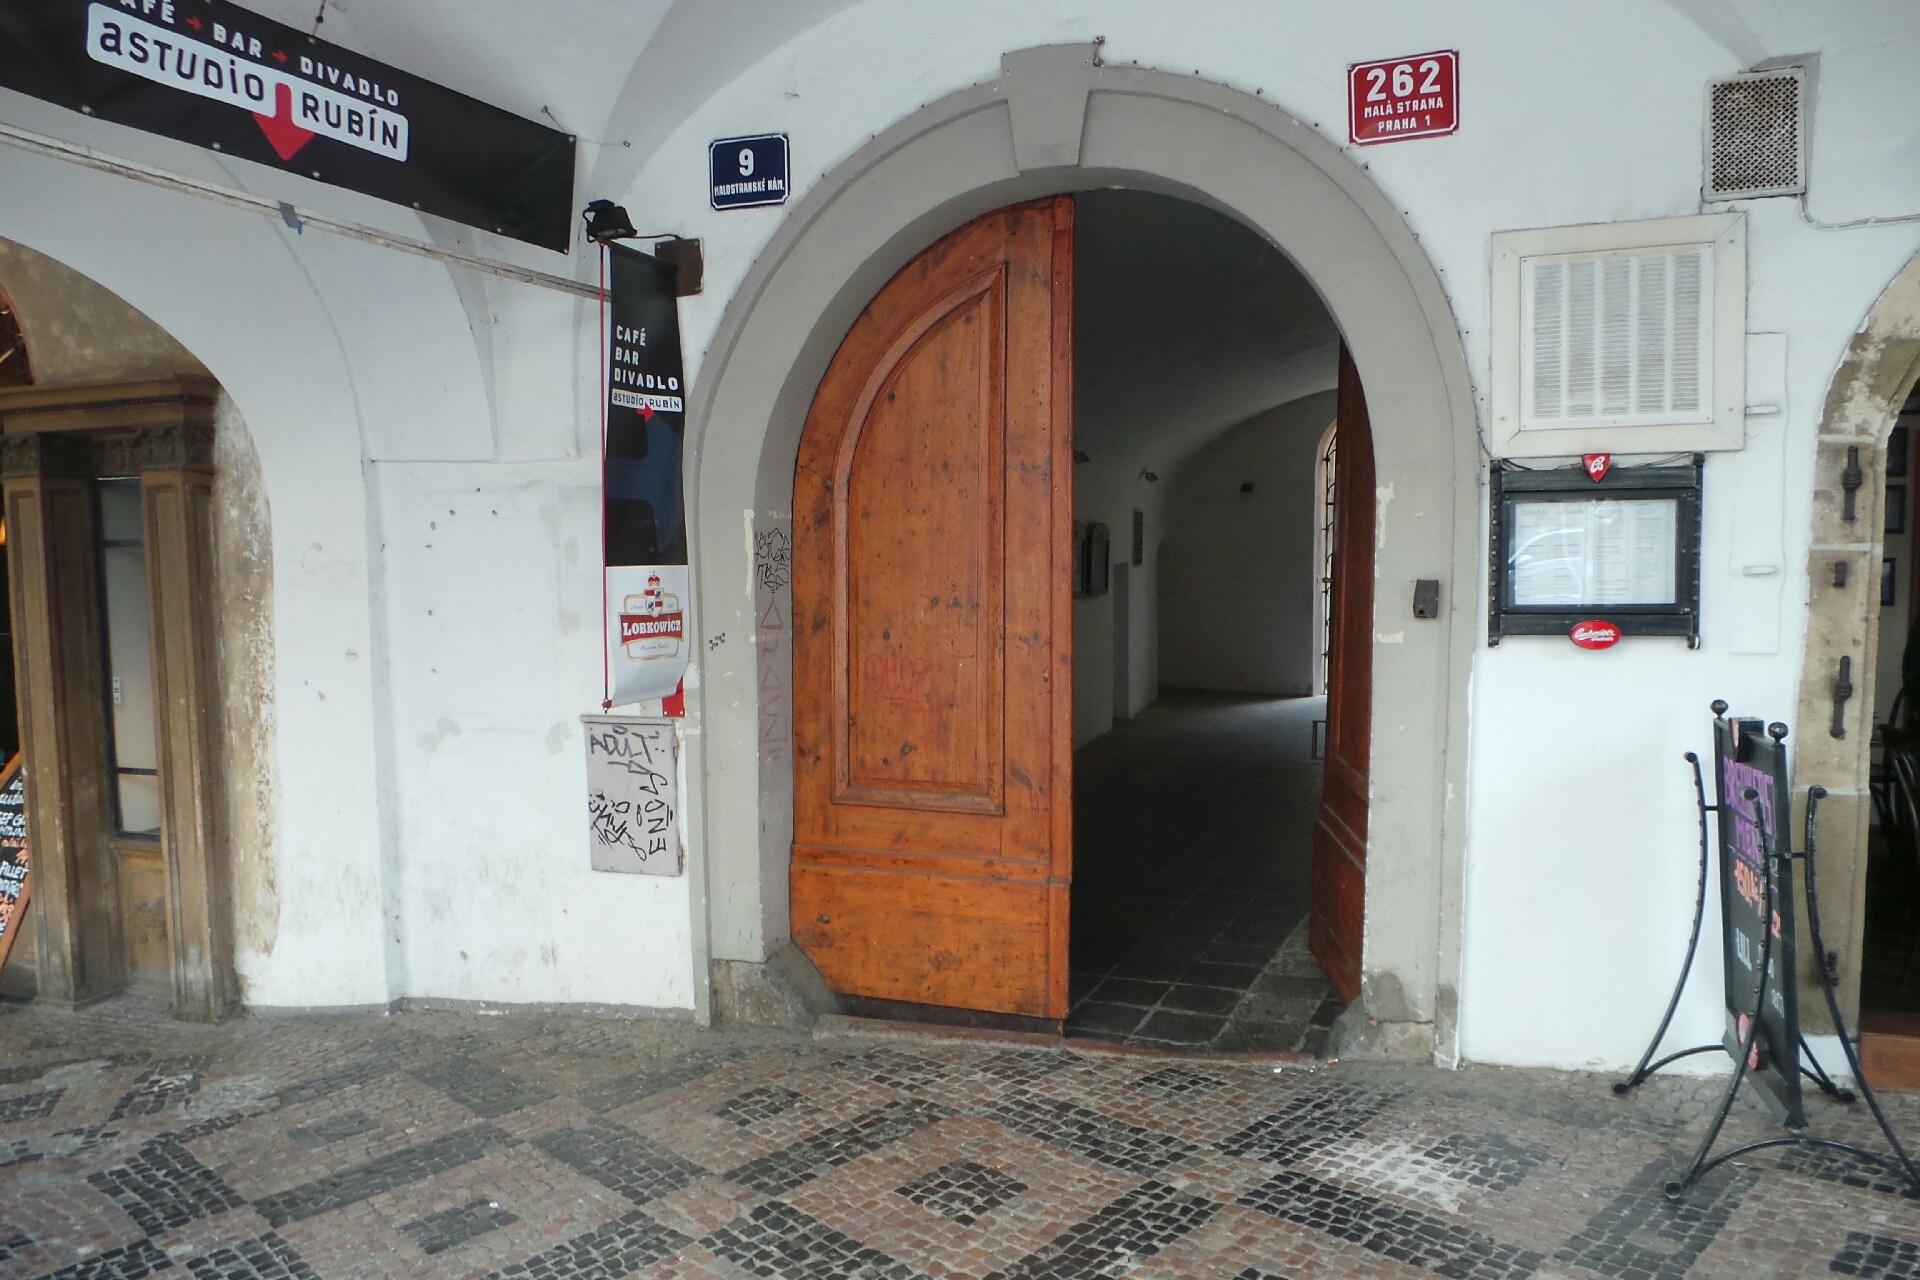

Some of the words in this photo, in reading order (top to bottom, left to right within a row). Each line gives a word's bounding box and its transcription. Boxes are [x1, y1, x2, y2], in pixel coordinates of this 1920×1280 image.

[213, 22, 262, 59] BAR
[300, 55, 399, 107] DIVADLO
[1366, 60, 1441, 103] 262
[1364, 100, 1393, 118] MALÁ
[1397, 97, 1443, 114] STRANA
[302, 91, 398, 149] RUBÍN
[1378, 117, 1417, 133] PRAHA
[1425, 115, 1431, 126] 1
[738, 148, 754, 177] 9
[714, 177, 766, 197] MALOSTRANSKÉ
[767, 176, 785, 191] NÁM.
[616, 324, 646, 346] CAFÉ
[615, 346, 639, 366] BAR
[614, 367, 679, 391] DIVADLO
[649, 397, 680, 409] RUBÍN
